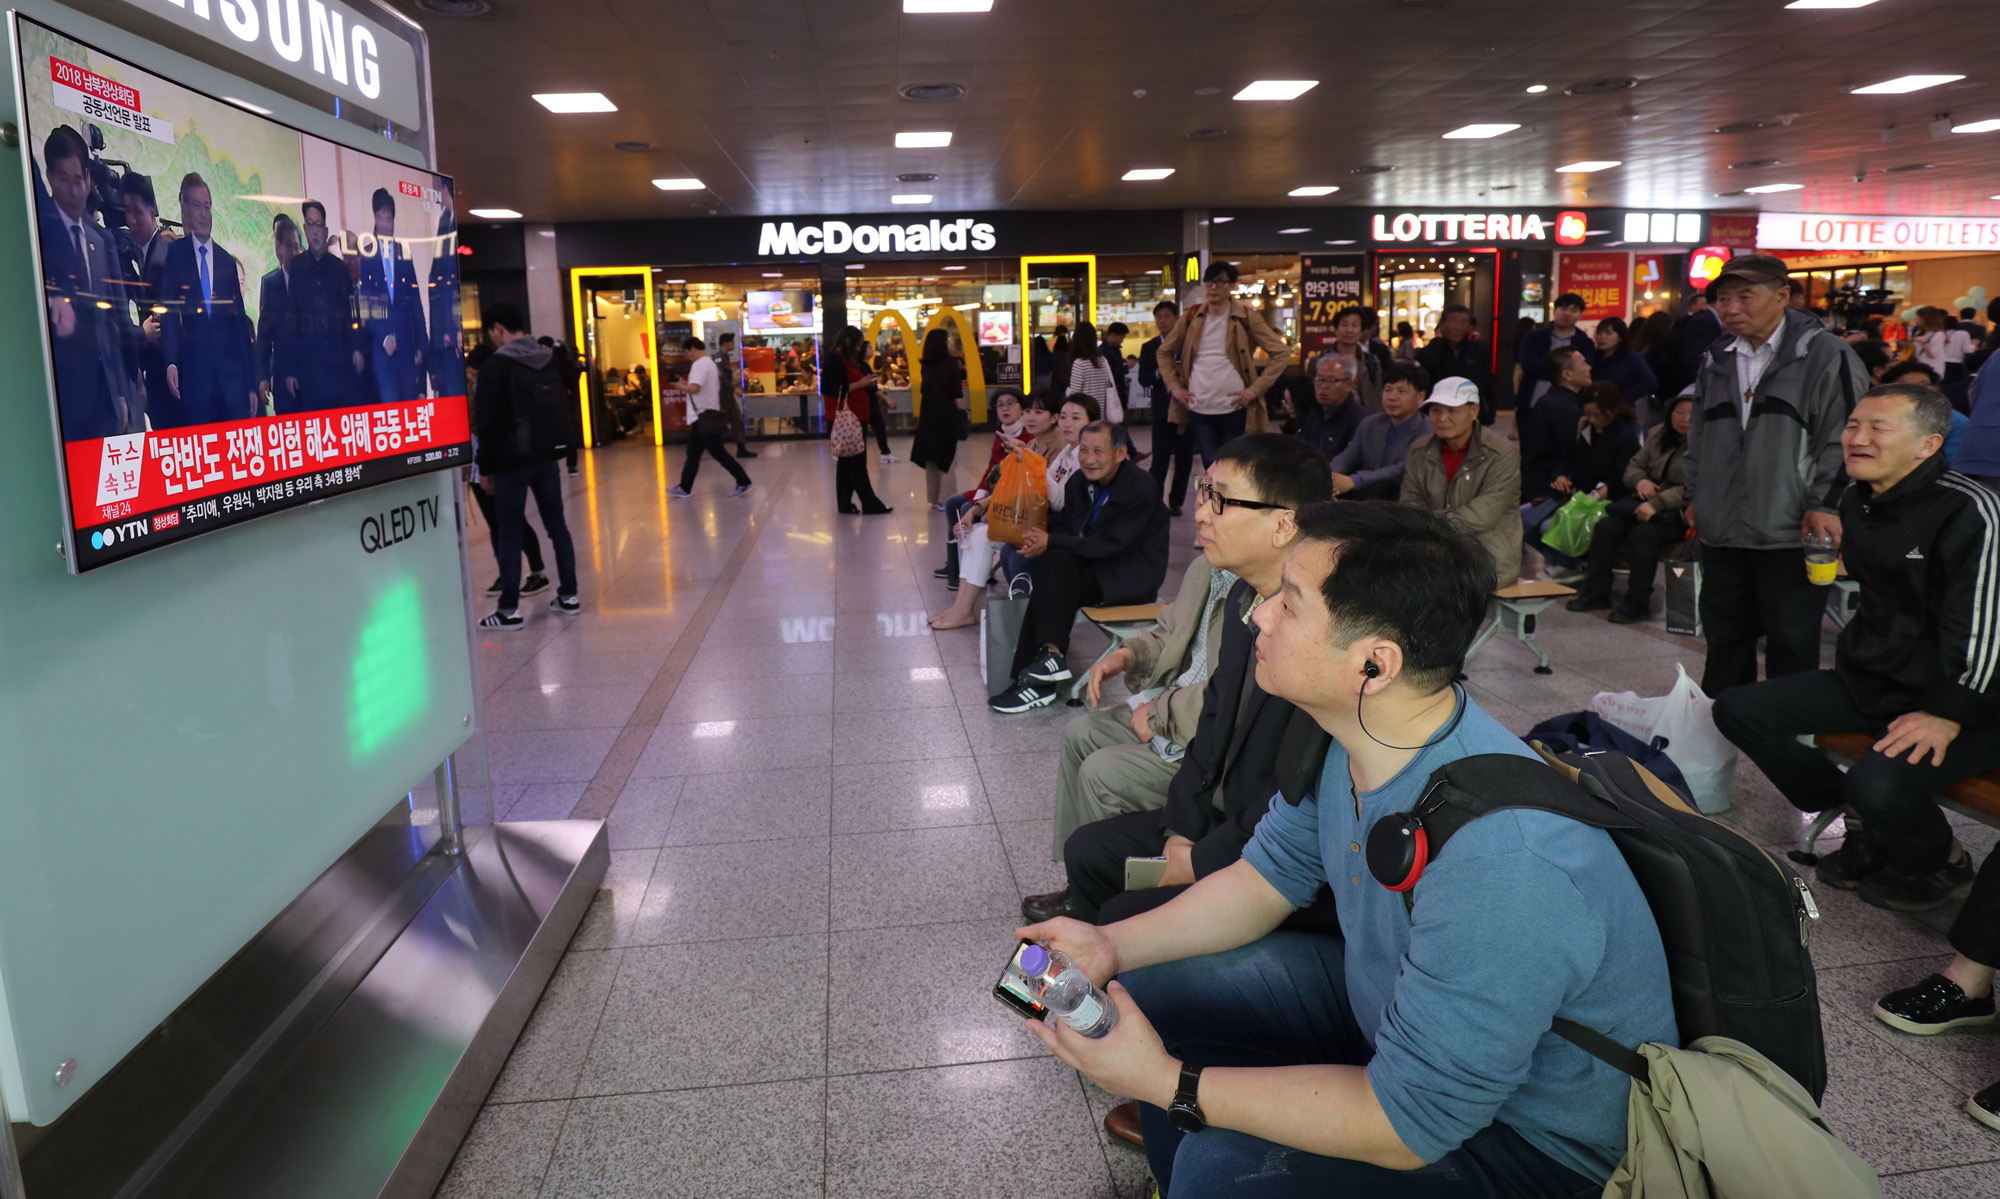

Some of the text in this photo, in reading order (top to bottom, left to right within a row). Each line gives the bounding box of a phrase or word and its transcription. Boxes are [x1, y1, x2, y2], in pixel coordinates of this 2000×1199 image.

[168, 0, 381, 100] SUNG
[55, 62, 135, 107] 2018 남북정상회담
[83, 94, 152, 133] 공동선언문 발표
[421, 187, 443, 204] YTN
[757, 218, 997, 256] McDonald's
[1371, 213, 1546, 242] LOTTERIA
[1800, 219, 1999, 245] LOTTE OUTLETS
[1567, 287, 1620, 308] 컴세트
[106, 440, 140, 467] 뉴스
[149, 402, 435, 496] "한반도 전쟁 위험 해소 위해 공동 노력"
[104, 469, 138, 496] 속보
[222, 490, 255, 514] 우원식,
[256, 482, 284, 504] 박지원
[285, 480, 295, 498] 등
[295, 476, 313, 495] 우리
[314, 473, 323, 490] 측
[324, 468, 344, 487] 34명
[344, 464, 363, 482] 참석"
[115, 518, 149, 543] YTN
[153, 512, 180, 531] 정상회담
[360, 495, 439, 554] QLED TV
